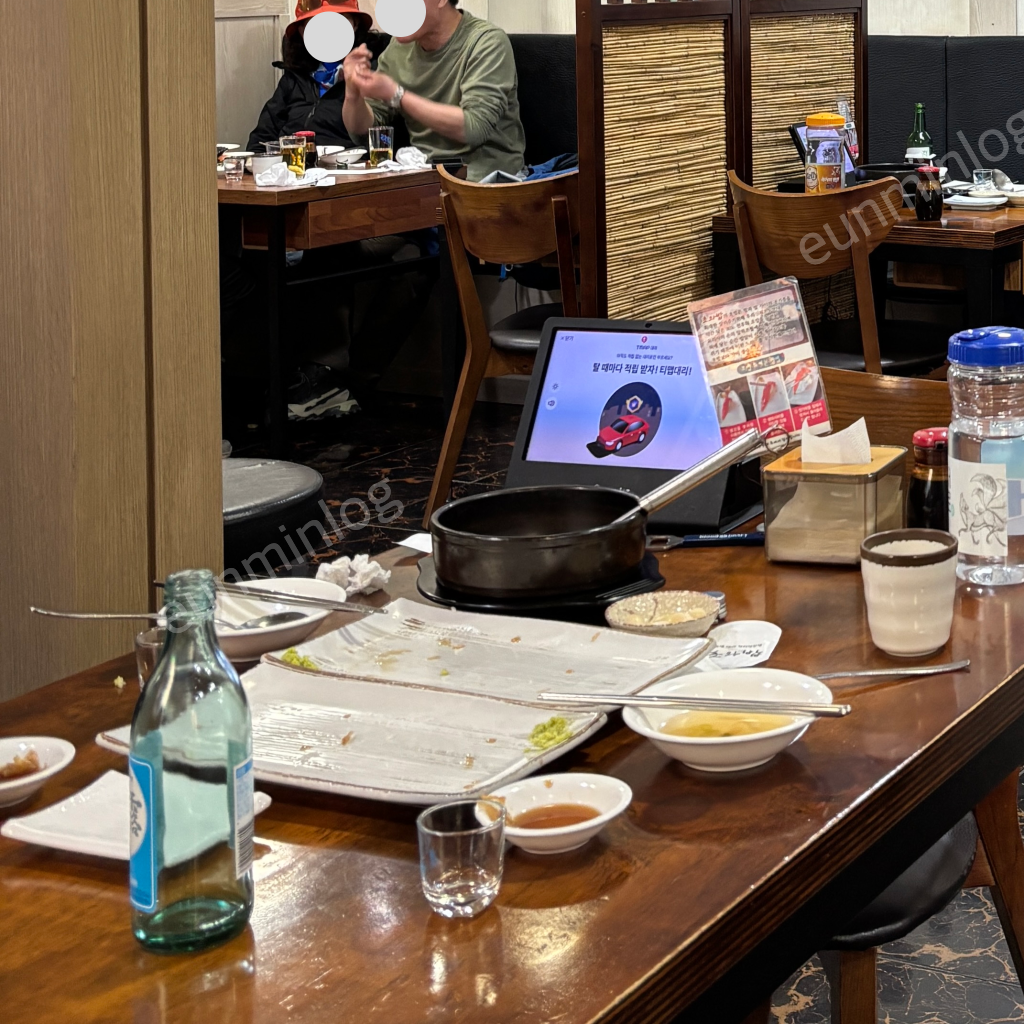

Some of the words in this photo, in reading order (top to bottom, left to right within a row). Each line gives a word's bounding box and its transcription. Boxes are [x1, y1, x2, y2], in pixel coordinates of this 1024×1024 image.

[592, 362, 601, 372] 탈
[601, 362, 623, 374] 때마다
[624, 363, 639, 374] 적립
[640, 364, 659, 375] 받자!
[659, 365, 692, 376] 티맵대리!
